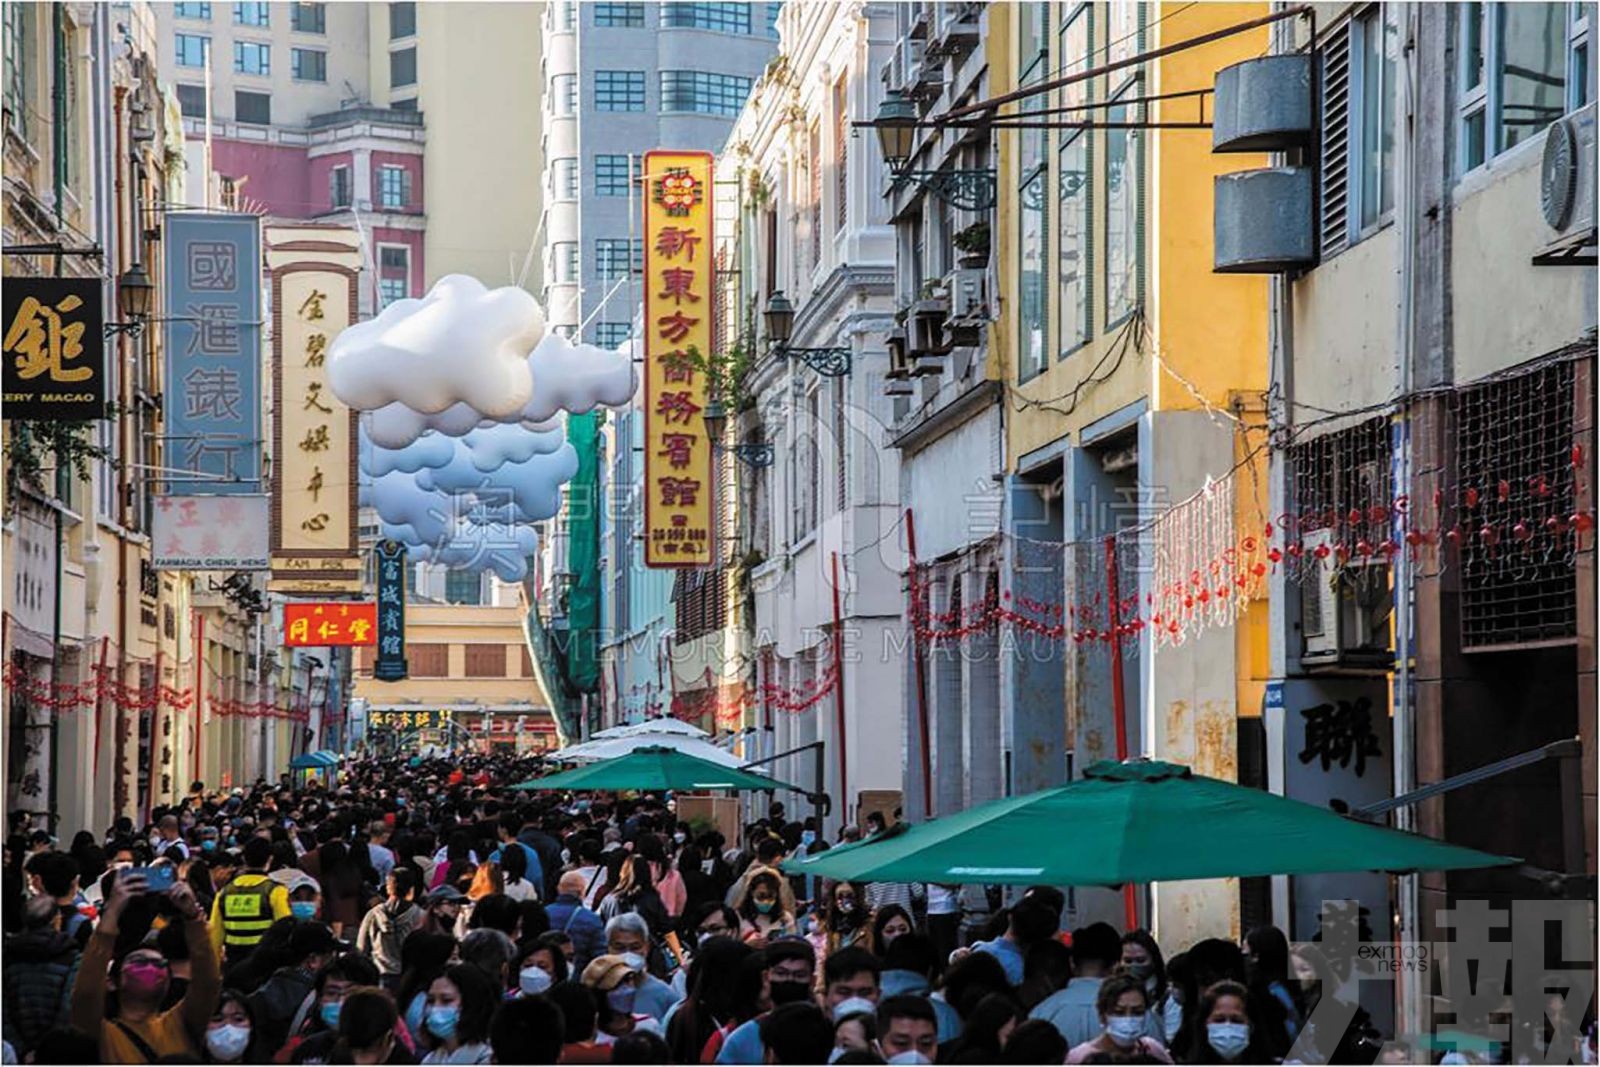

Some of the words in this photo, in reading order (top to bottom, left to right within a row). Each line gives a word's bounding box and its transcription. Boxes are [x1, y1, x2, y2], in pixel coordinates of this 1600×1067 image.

[41, 393, 95, 403] MACAO
[155, 558, 201, 567] FARMACIA
[205, 558, 238, 567] CHENG
[289, 617, 372, 643] 同仁堂
